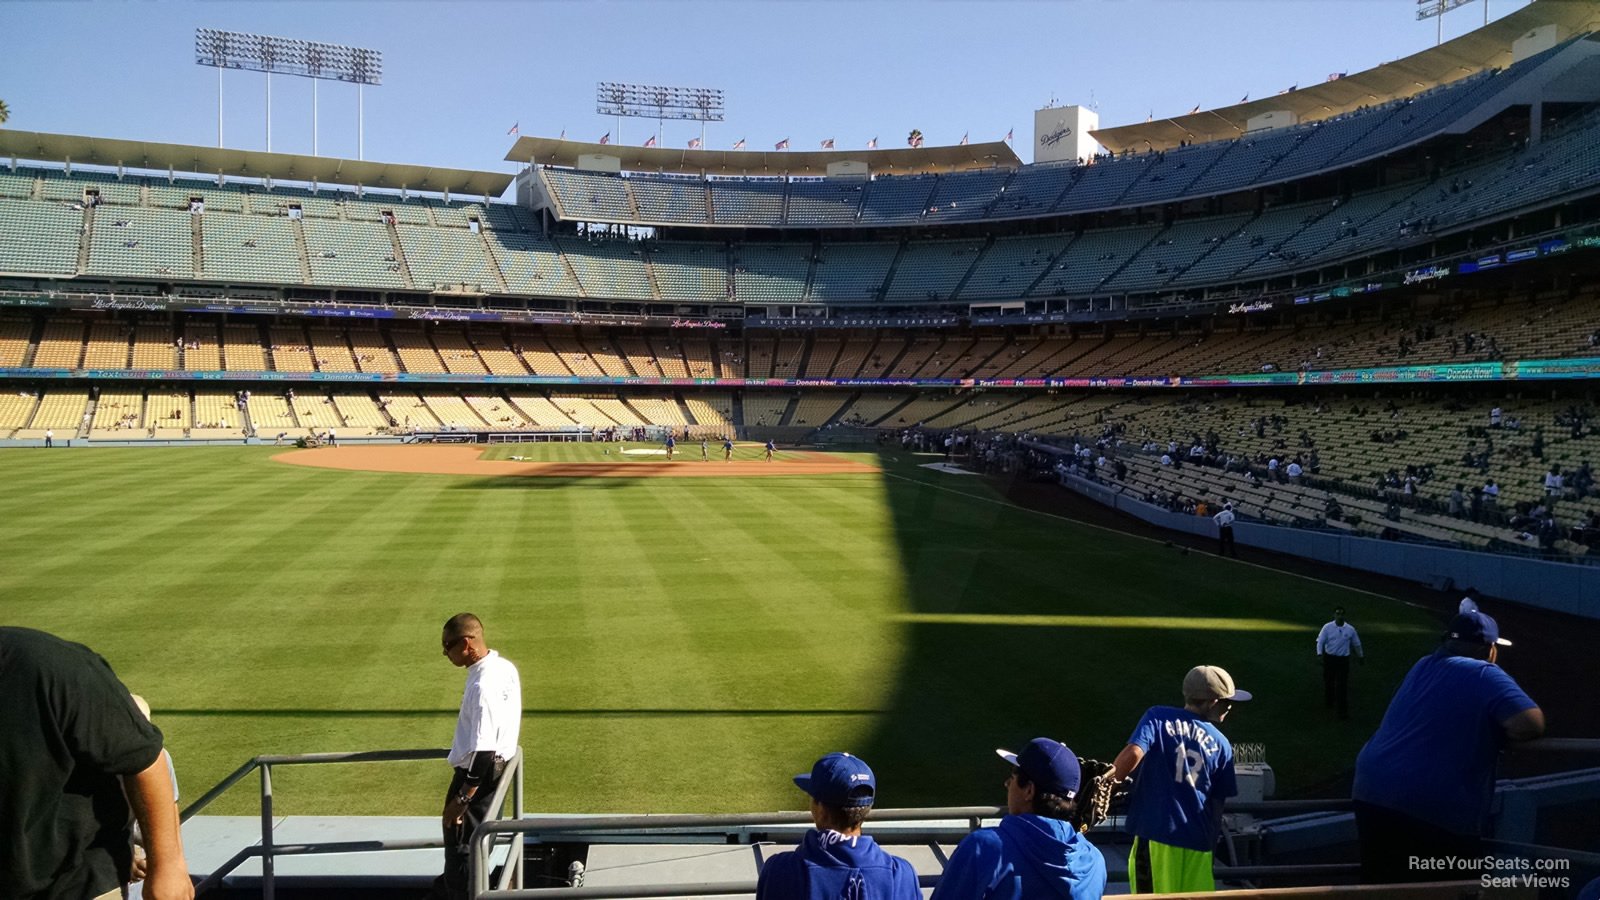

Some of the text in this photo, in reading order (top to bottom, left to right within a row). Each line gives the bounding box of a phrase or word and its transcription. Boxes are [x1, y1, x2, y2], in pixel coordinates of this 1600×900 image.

[1040, 127, 1072, 146] Dodgers
[91, 299, 167, 311] Los Angeles Dodgers
[419, 311, 445, 320] Angeles
[444, 312, 470, 321] Dodgers
[97, 370, 119, 378] Text
[1446, 367, 1473, 380] Donate
[1473, 366, 1493, 379] Now!
[1151, 378, 1165, 386] Now!
